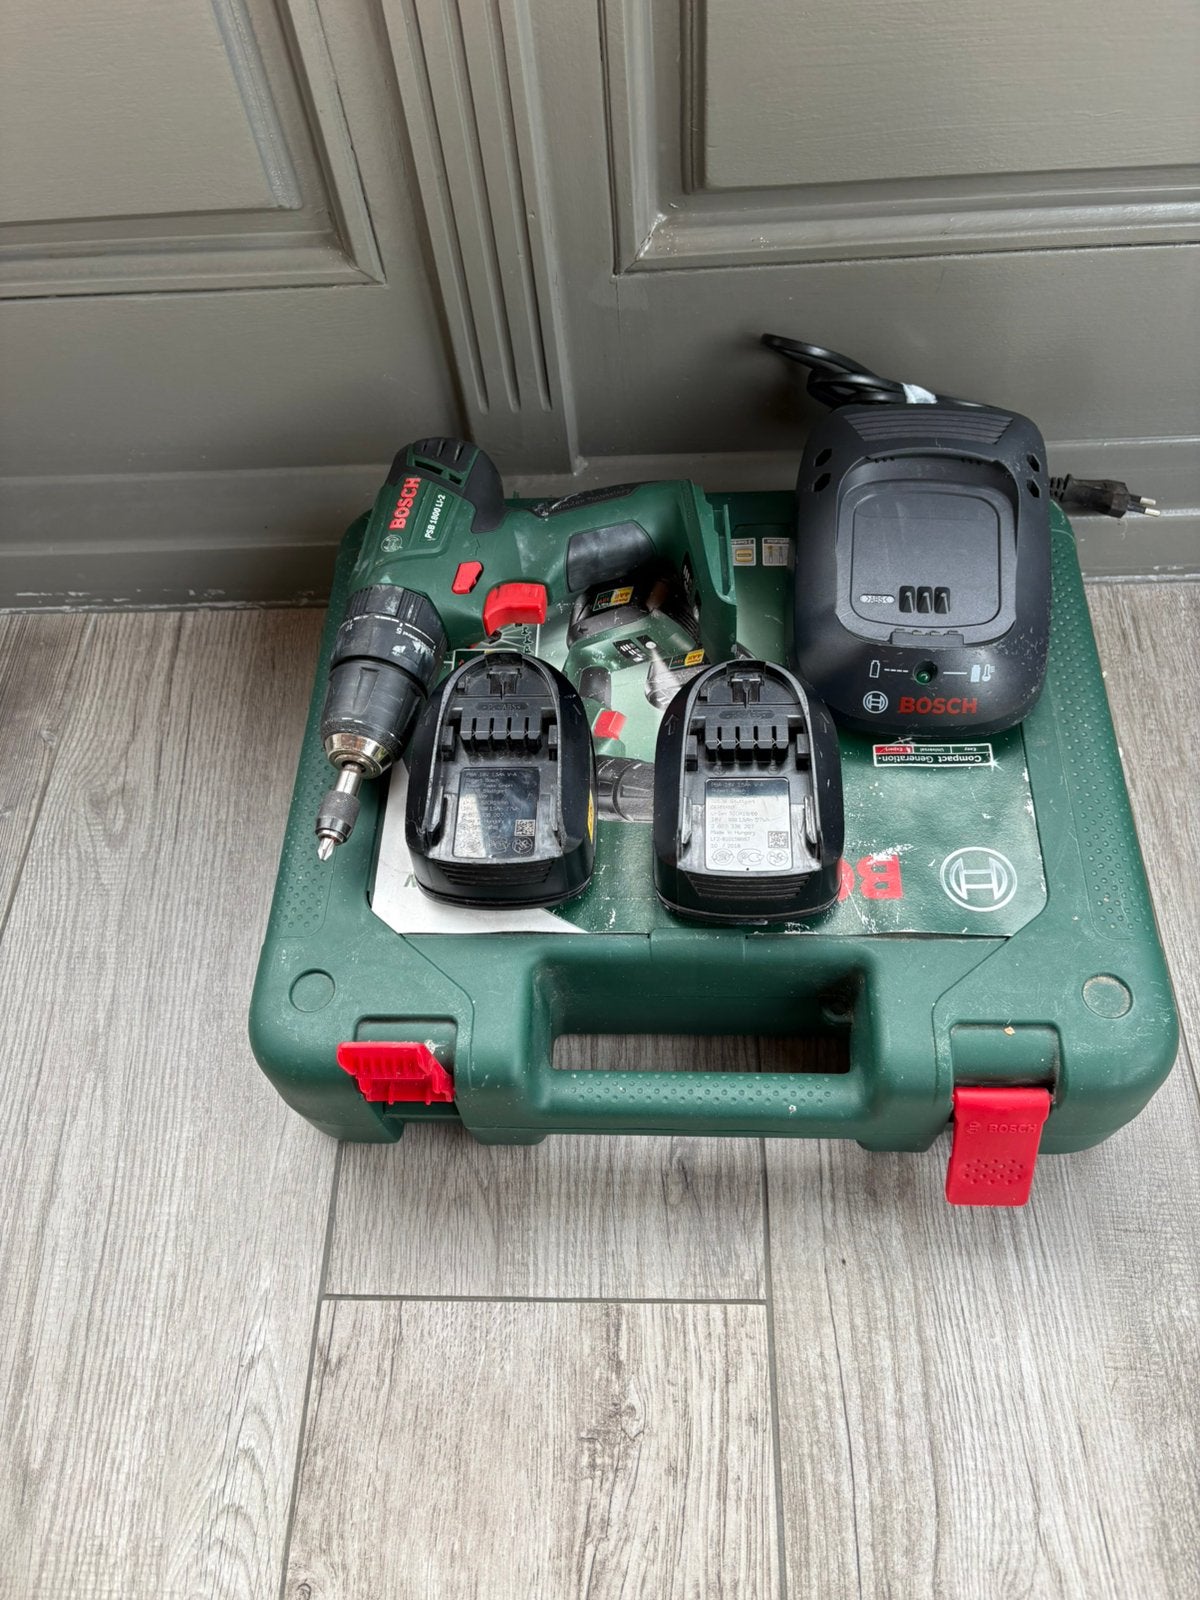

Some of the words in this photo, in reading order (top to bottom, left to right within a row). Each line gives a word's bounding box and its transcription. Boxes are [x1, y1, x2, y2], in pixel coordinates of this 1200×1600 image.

[388, 477, 422, 530] BOSCH
[424, 524, 436, 539] PSB
[430, 507, 441, 524] 1800
[898, 696, 977, 715] BOSCH
[938, 754, 982, 763] Compact
[988, 1122, 1038, 1134] BOSCH
